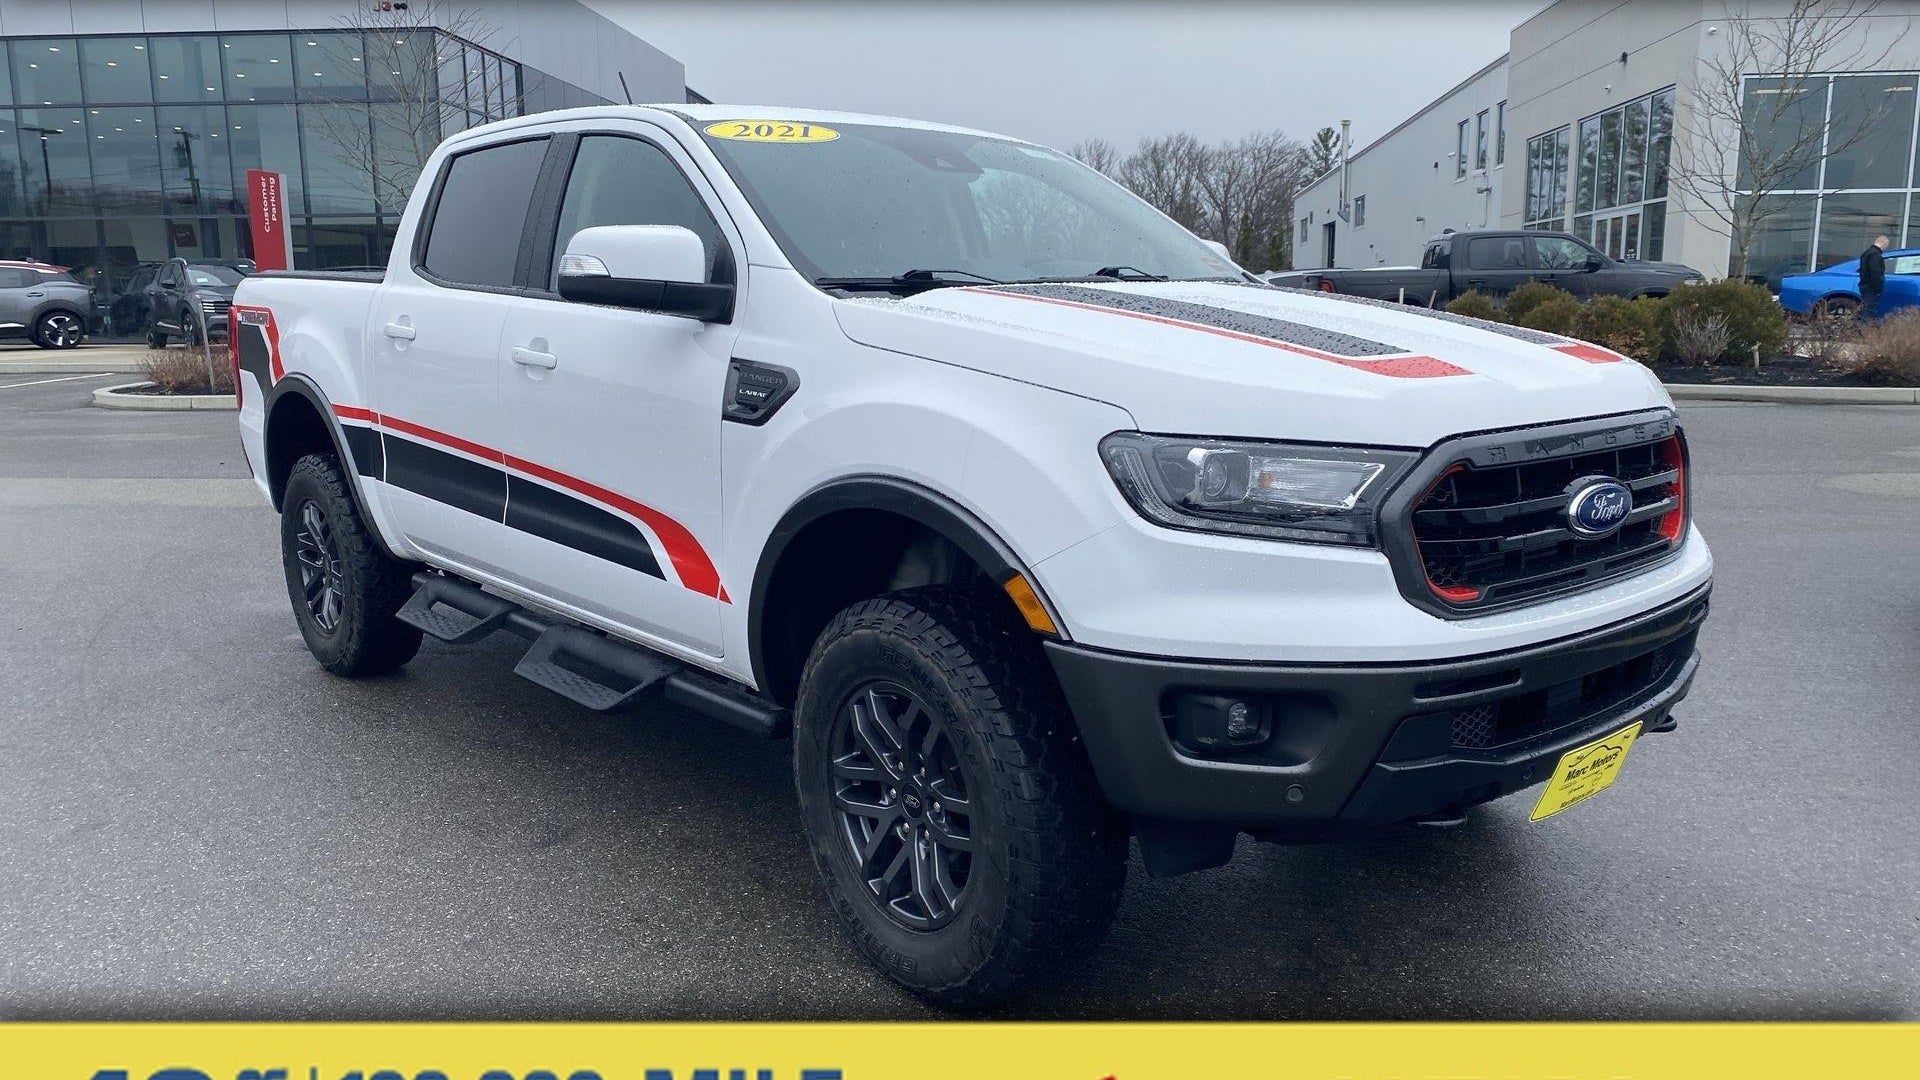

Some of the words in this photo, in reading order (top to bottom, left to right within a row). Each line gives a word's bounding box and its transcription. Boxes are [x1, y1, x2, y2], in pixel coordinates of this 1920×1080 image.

[733, 124, 811, 138] 2021
[261, 176, 270, 233] Customer
[739, 388, 768, 398] LARIAT
[1487, 421, 1671, 462] RANGER
[1591, 492, 1624, 521] Ford
[1564, 766, 1589, 782] Marc
[1589, 751, 1620, 772] Motors
